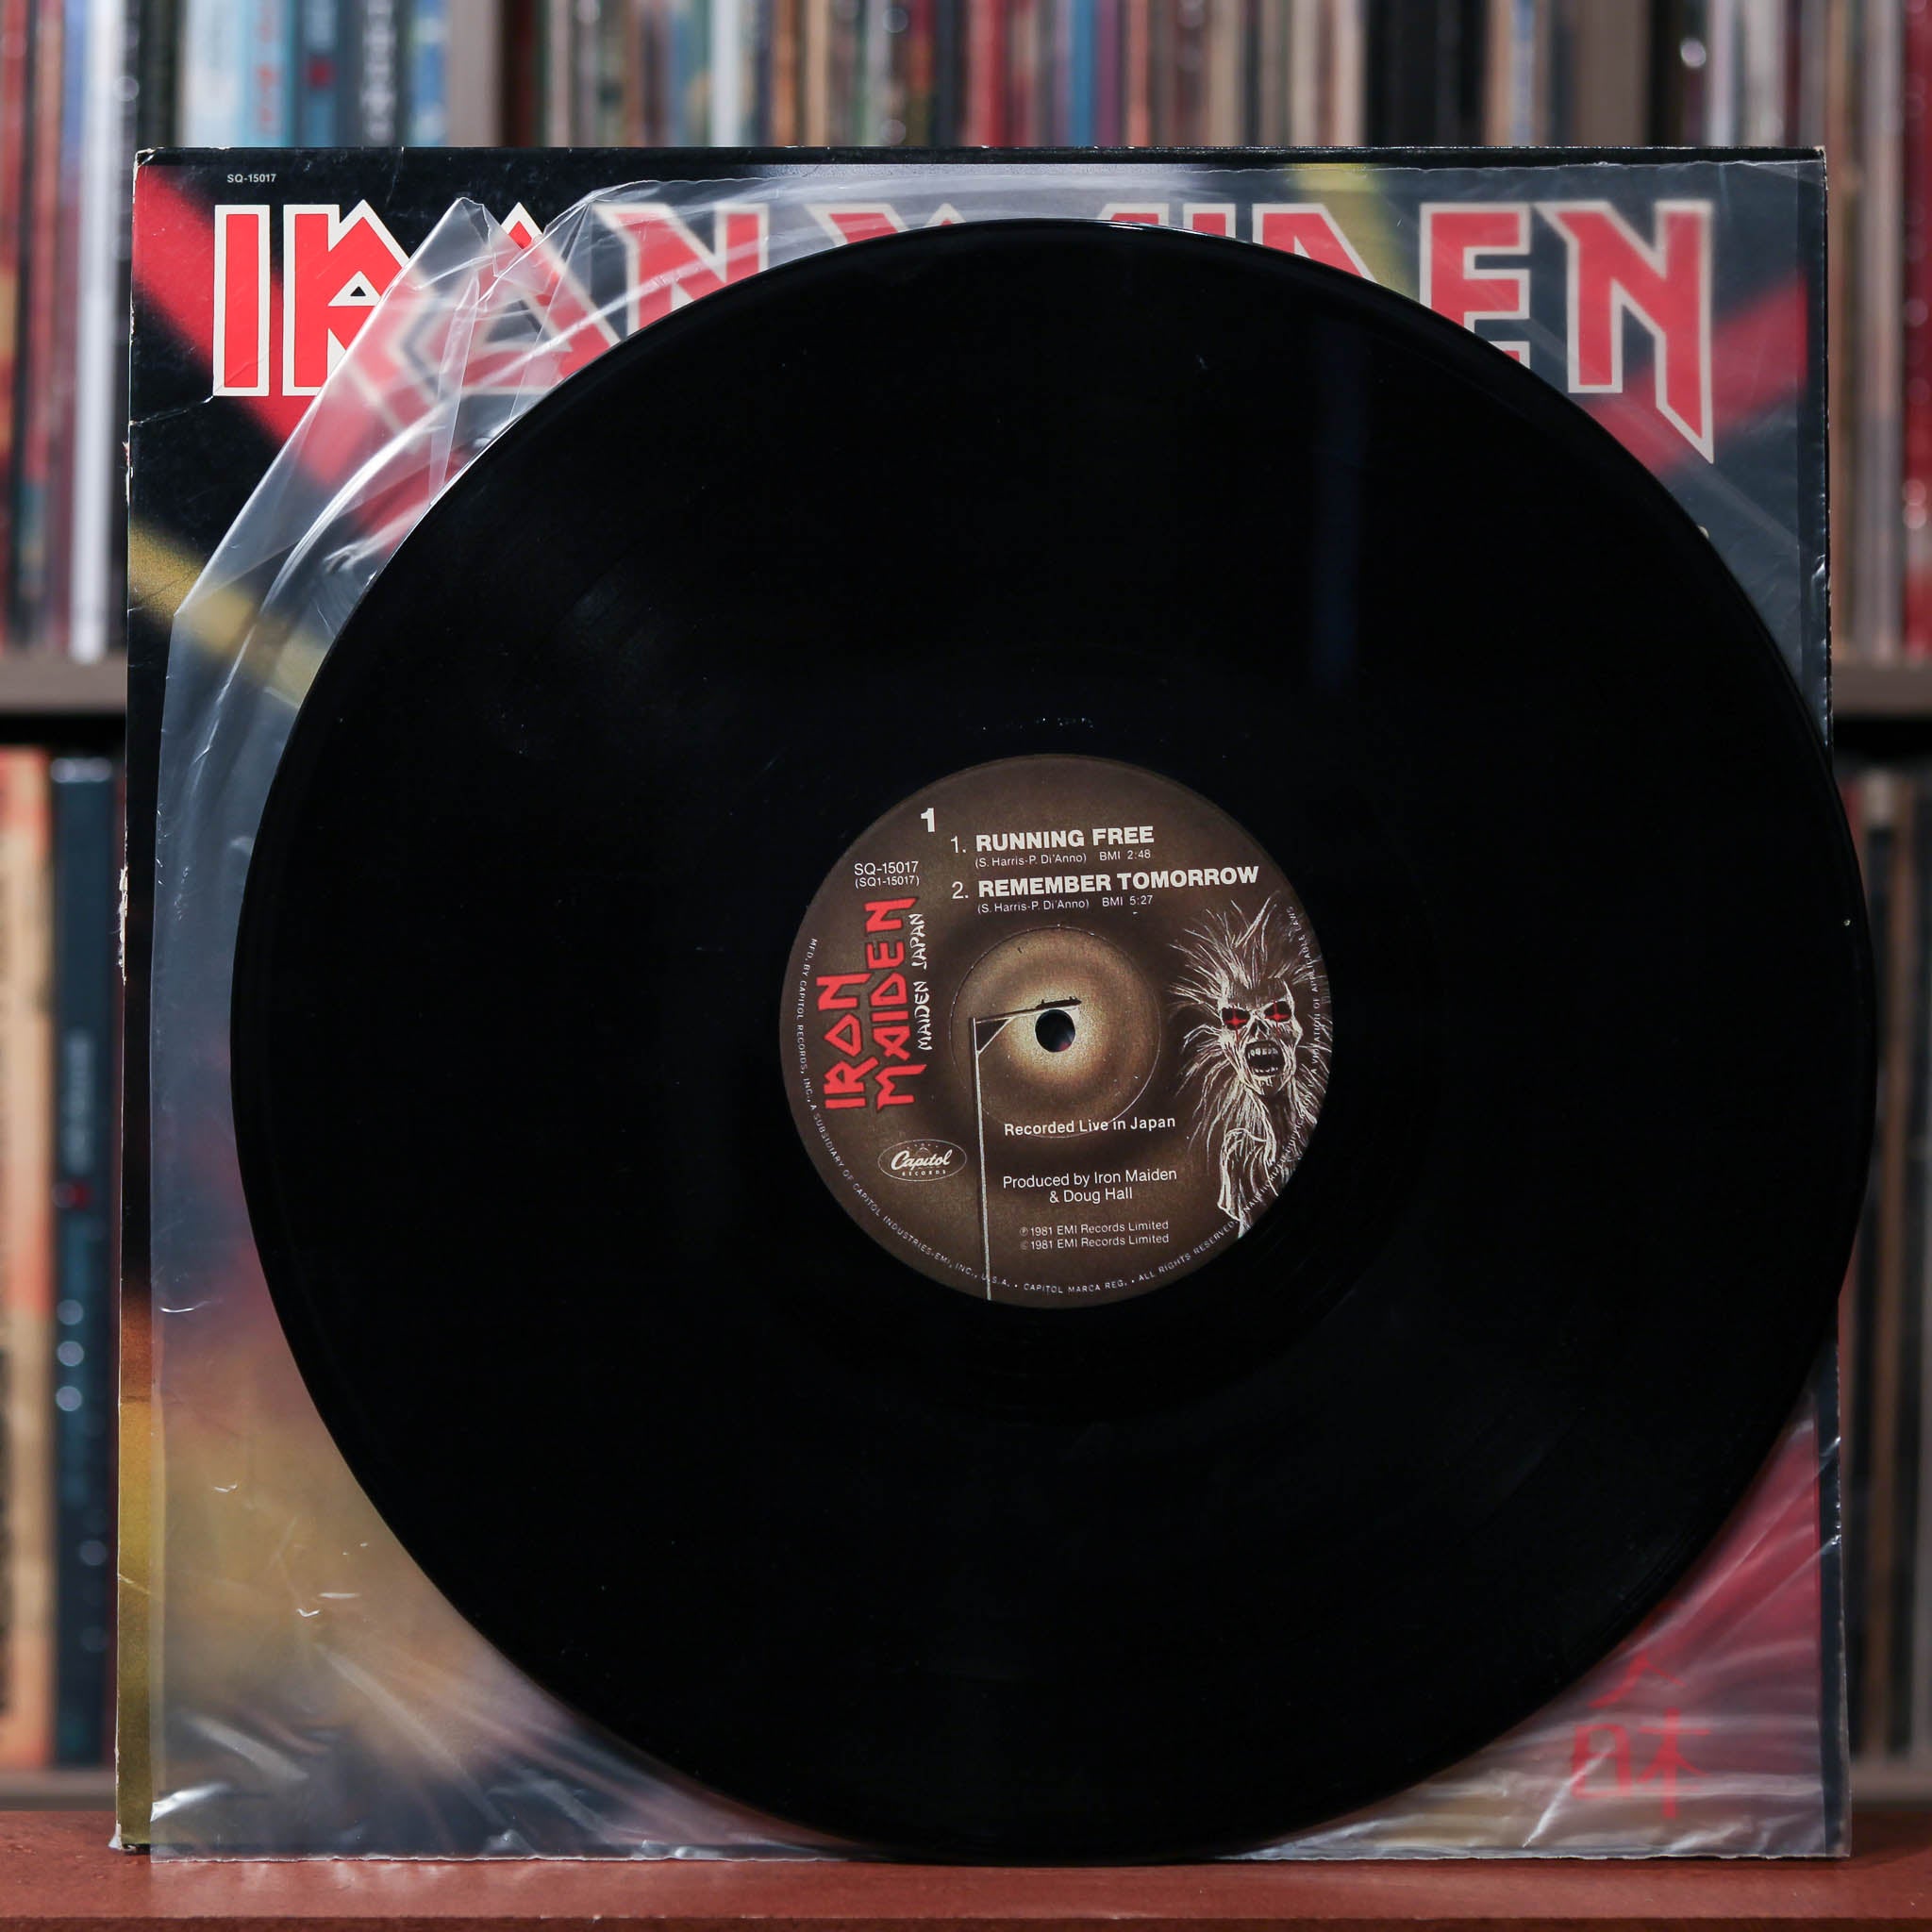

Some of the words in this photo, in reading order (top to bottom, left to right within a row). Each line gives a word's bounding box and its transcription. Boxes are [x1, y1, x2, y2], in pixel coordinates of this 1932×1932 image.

[226, 174, 277, 183] SQ-15017
[920, 808, 936, 833] 1
[950, 835, 967, 854] 1.
[975, 829, 1085, 852] RUNNING
[1091, 825, 1155, 846] FREE
[854, 860, 919, 875] SQ-15017
[974, 858, 990, 868] (S.
[1099, 851, 1121, 861] BMI
[1127, 849, 1151, 860] 2:48
[855, 874, 920, 889] (SQ1-15017)
[951, 881, 969, 899] 2.
[978, 874, 1111, 898] REMEMBER
[1116, 866, 1259, 891] TOMORROW
[977, 903, 992, 914] (S.
[1102, 897, 1124, 908] BMI
[1129, 895, 1154, 906] 5:27
[908, 912, 928, 970] JAPAN
[802, 963, 811, 977] BY
[796, 980, 808, 1020] CAPITOL
[864, 896, 927, 1111] MAIDEN
[913, 980, 933, 1051] MAIDEN
[796, 1024, 808, 1074] RECORDS,
[816, 973, 880, 1109] IRON
[1004, 1120, 1074, 1136] Recorded
[1079, 1119, 1108, 1132] Live
[1113, 1117, 1125, 1130] in
[1130, 1116, 1175, 1131] Japan
[813, 1113, 845, 1166] SUBSIDIARY
[891, 1148, 953, 1171] Capitol
[842, 1169, 855, 1180] OF
[1003, 1174, 1070, 1189] Produced
[1074, 1173, 1090, 1188] by
[1094, 1172, 1121, 1184] Iron
[1125, 1168, 1177, 1182] Maiden
[853, 1182, 881, 1217] CAPITOL
[1049, 1191, 1059, 1203] &
[1063, 1190, 1101, 1205] Doug
[1105, 1187, 1133, 1200] Hall
[1058, 1225, 1077, 1235] EMI
[1080, 1223, 1125, 1234] Records
[1128, 1221, 1169, 1232] Limited
[1058, 1239, 1077, 1248] EMI
[1081, 1237, 1125, 1247] Records
[1128, 1234, 1170, 1245] Limited
[1158, 1253, 1191, 1274] RIGHTS
[1104, 1279, 1127, 1290] REG.
[1139, 1271, 1156, 1282] ALL
[1024, 1282, 1063, 1294] CAPITOL
[1068, 1284, 1101, 1292] MARCA
